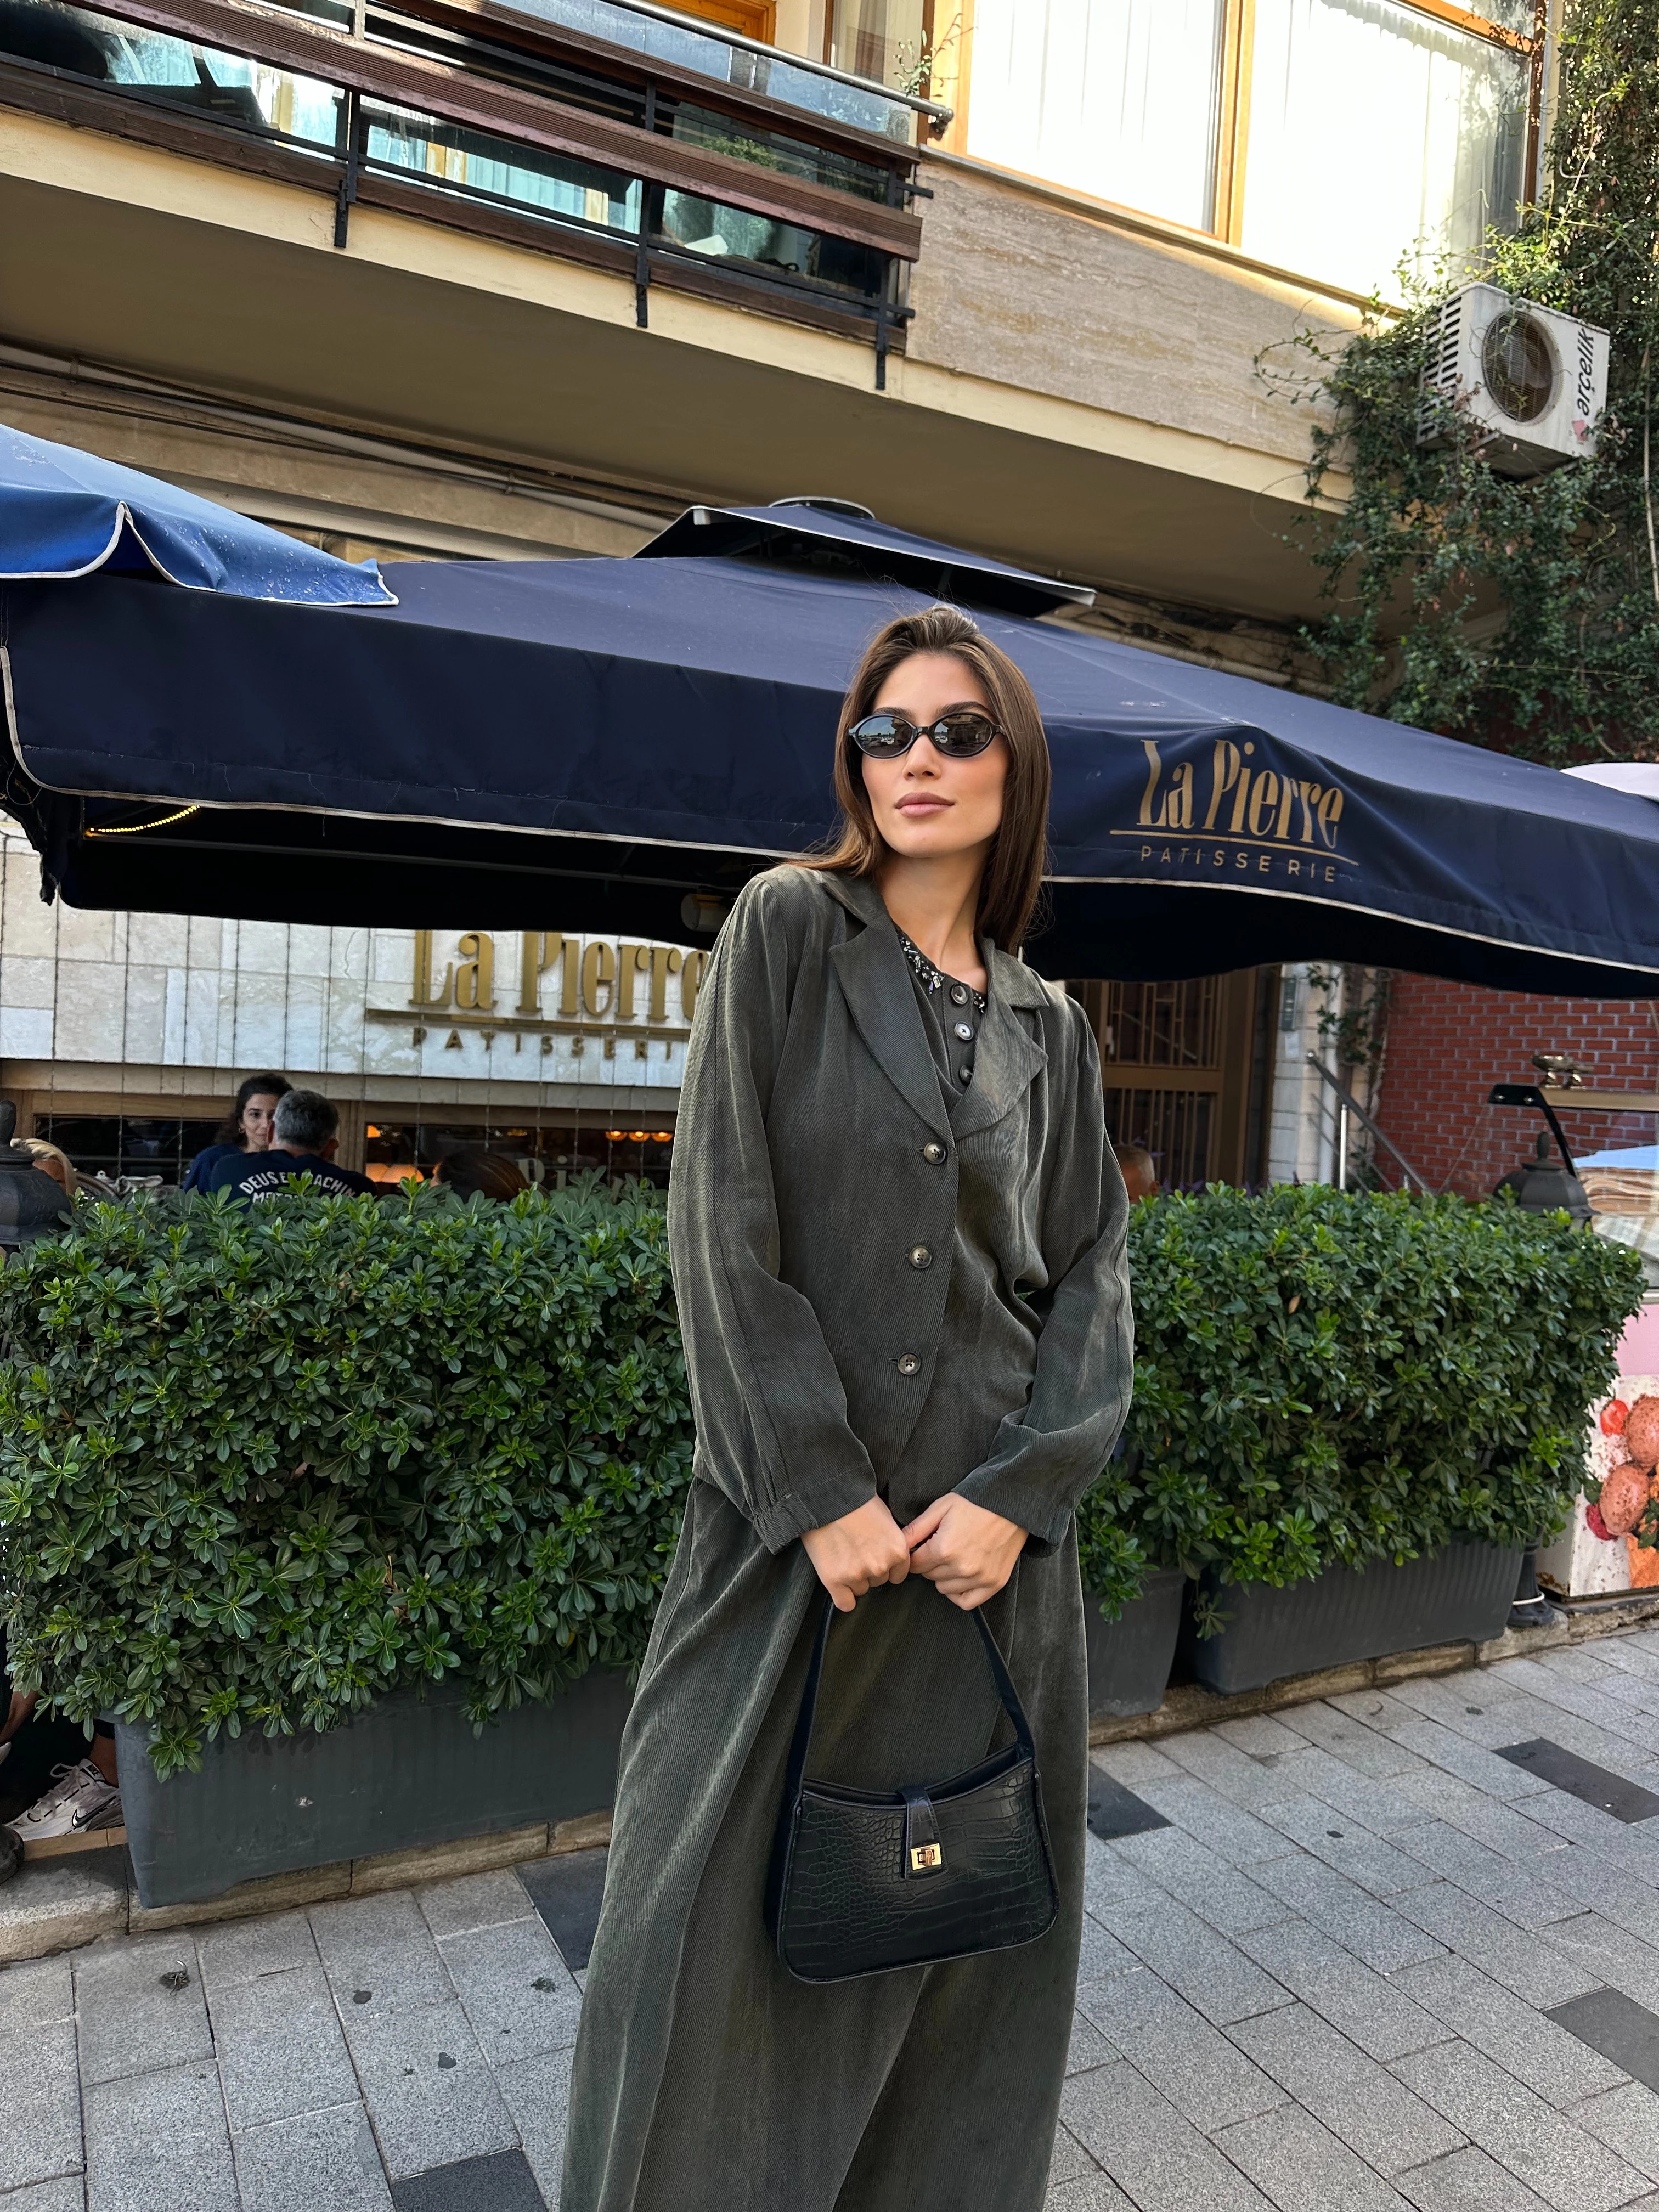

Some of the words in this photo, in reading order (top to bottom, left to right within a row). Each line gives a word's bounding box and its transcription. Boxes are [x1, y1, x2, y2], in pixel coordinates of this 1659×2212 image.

[1577, 328, 1595, 416] arçelik
[1137, 740, 1195, 830] La
[1201, 740, 1344, 849] Pierre
[1141, 845, 1335, 883] PATISSERIE
[408, 930, 498, 1010] La
[515, 931, 709, 1022] Pierre
[413, 1027, 672, 1060] PATISSERI
[239, 1171, 279, 1194] DEUS
